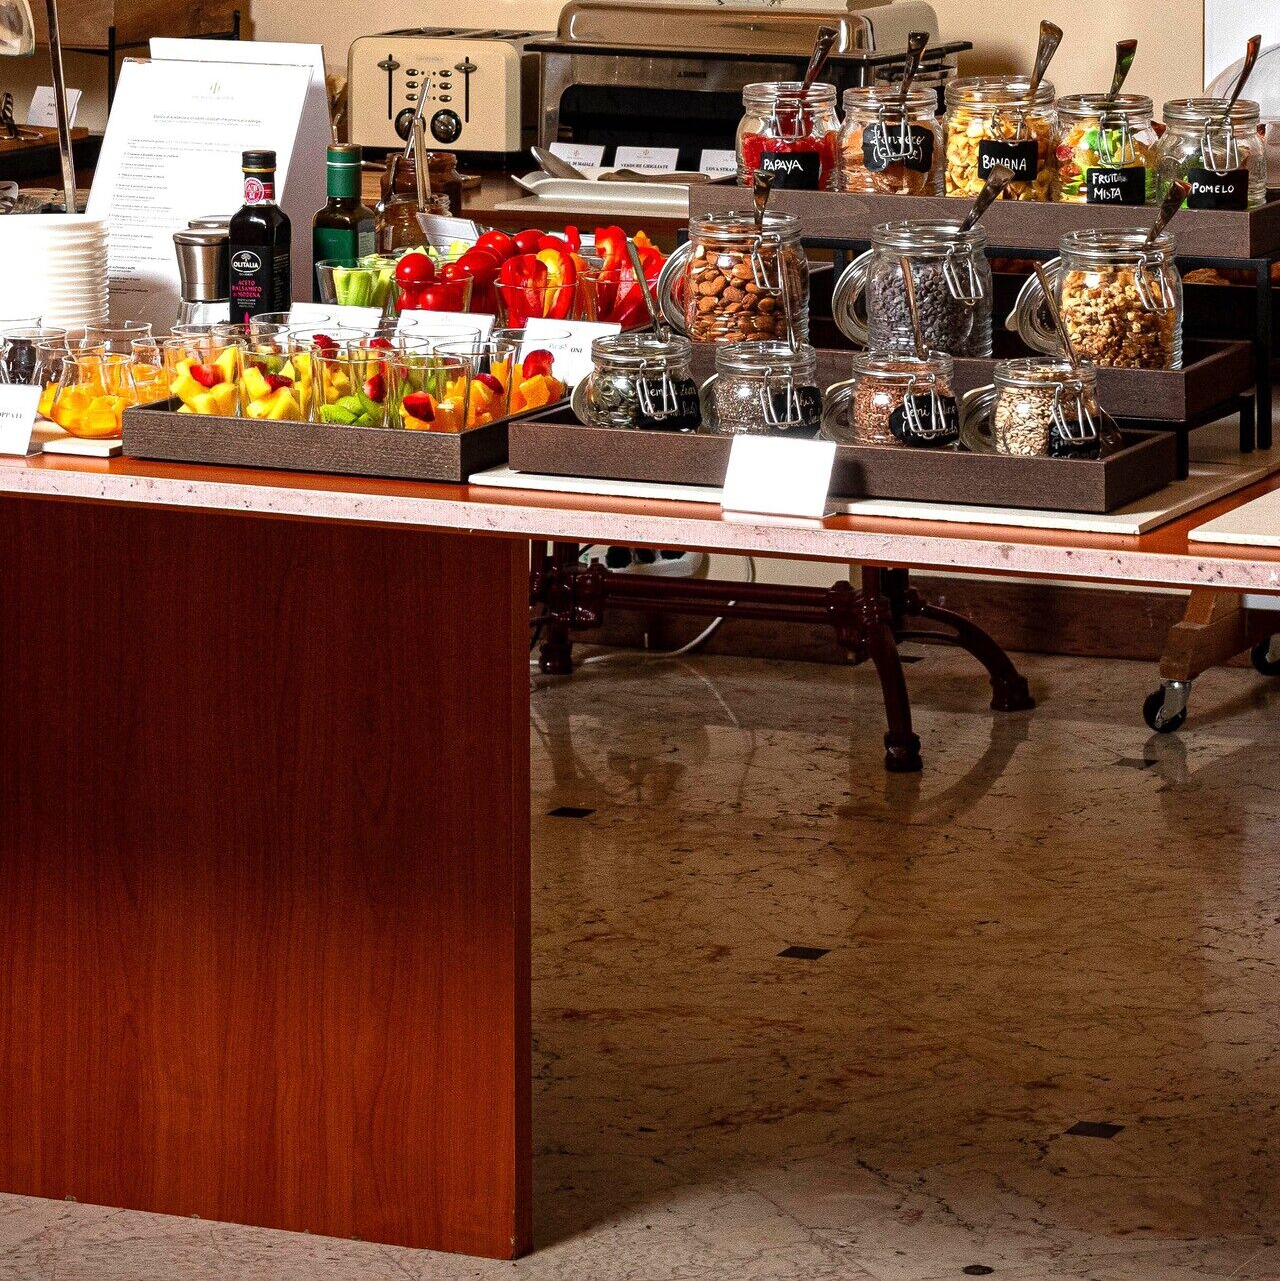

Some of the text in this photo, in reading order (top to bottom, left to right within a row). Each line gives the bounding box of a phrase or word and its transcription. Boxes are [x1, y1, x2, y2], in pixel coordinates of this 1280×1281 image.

[763, 158, 803, 175] PAPAYA
[982, 154, 1027, 171] BANANA
[1093, 187, 1123, 201] MISTA
[1192, 181, 1235, 195] POMELO
[233, 260, 259, 269] OLITALIA
[231, 284, 262, 292] BALSAMICO
